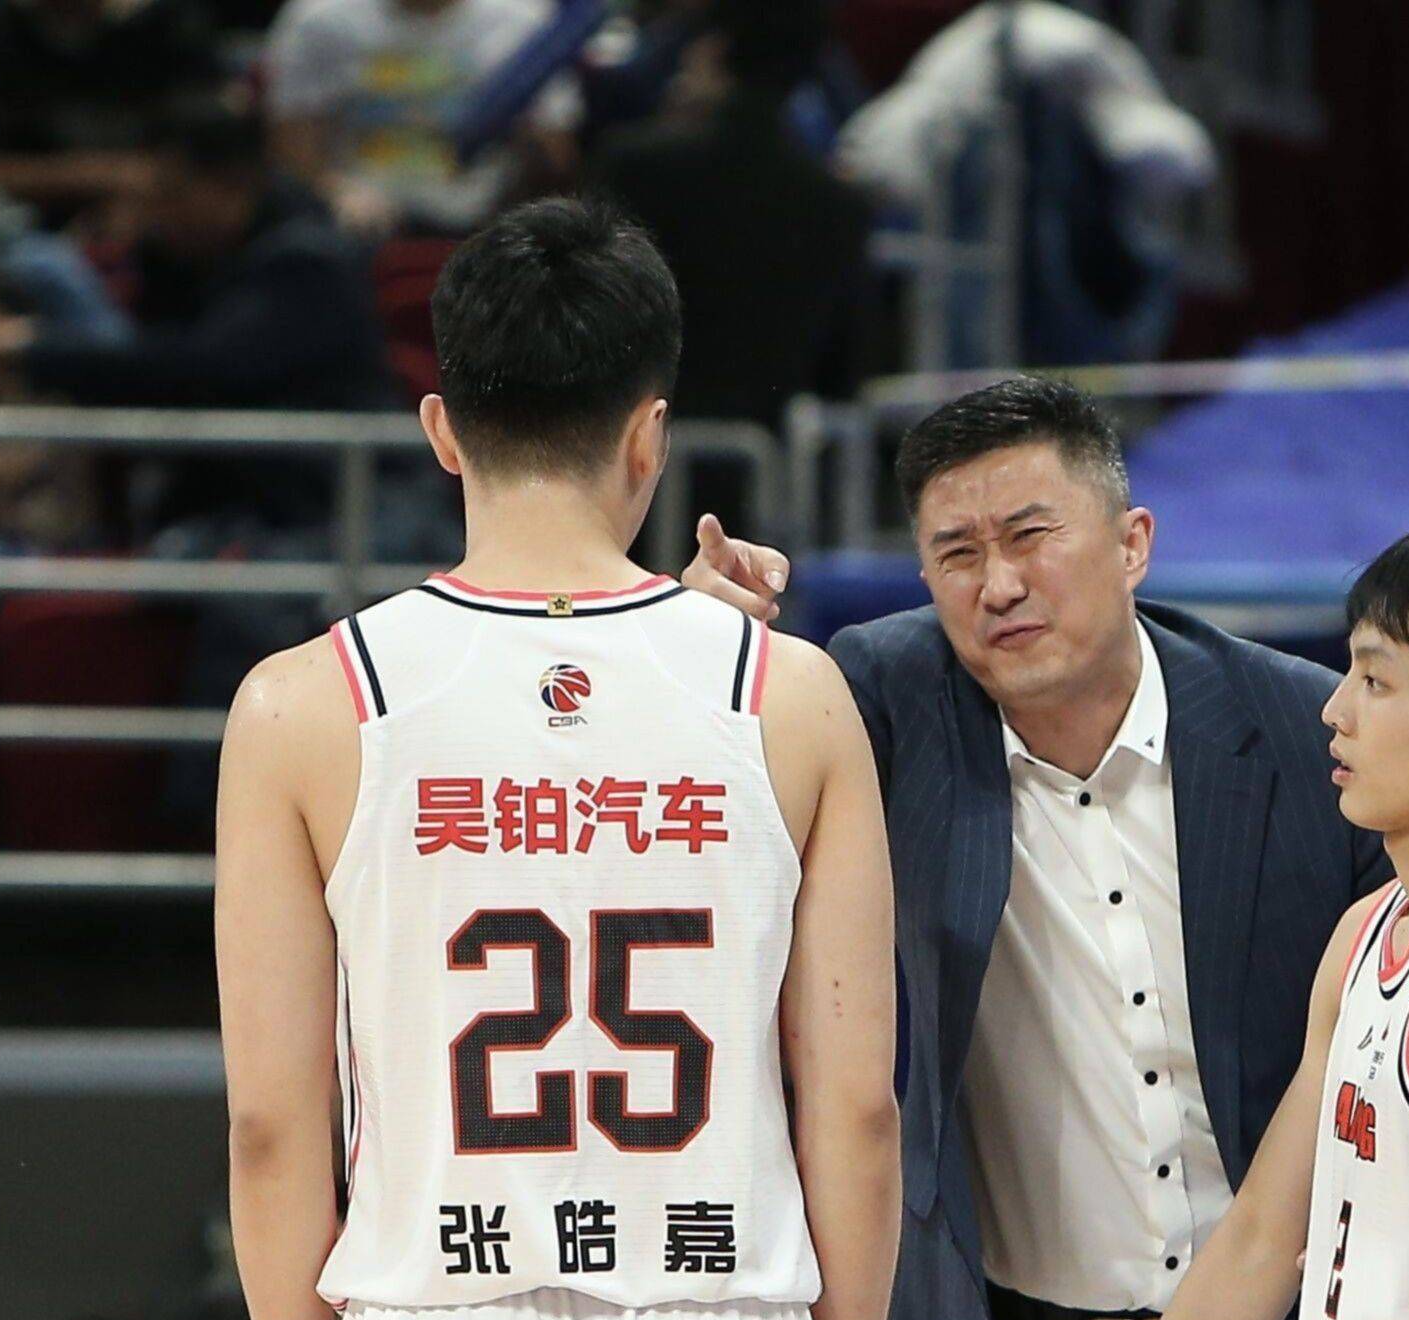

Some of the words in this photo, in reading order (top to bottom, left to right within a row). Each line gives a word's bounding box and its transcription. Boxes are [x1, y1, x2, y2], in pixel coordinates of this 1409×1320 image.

[547, 715, 588, 728] CBA
[413, 776, 729, 856] 昊铂汽车
[445, 907, 715, 1156] 25
[438, 1200, 737, 1276] 张皓嘉
